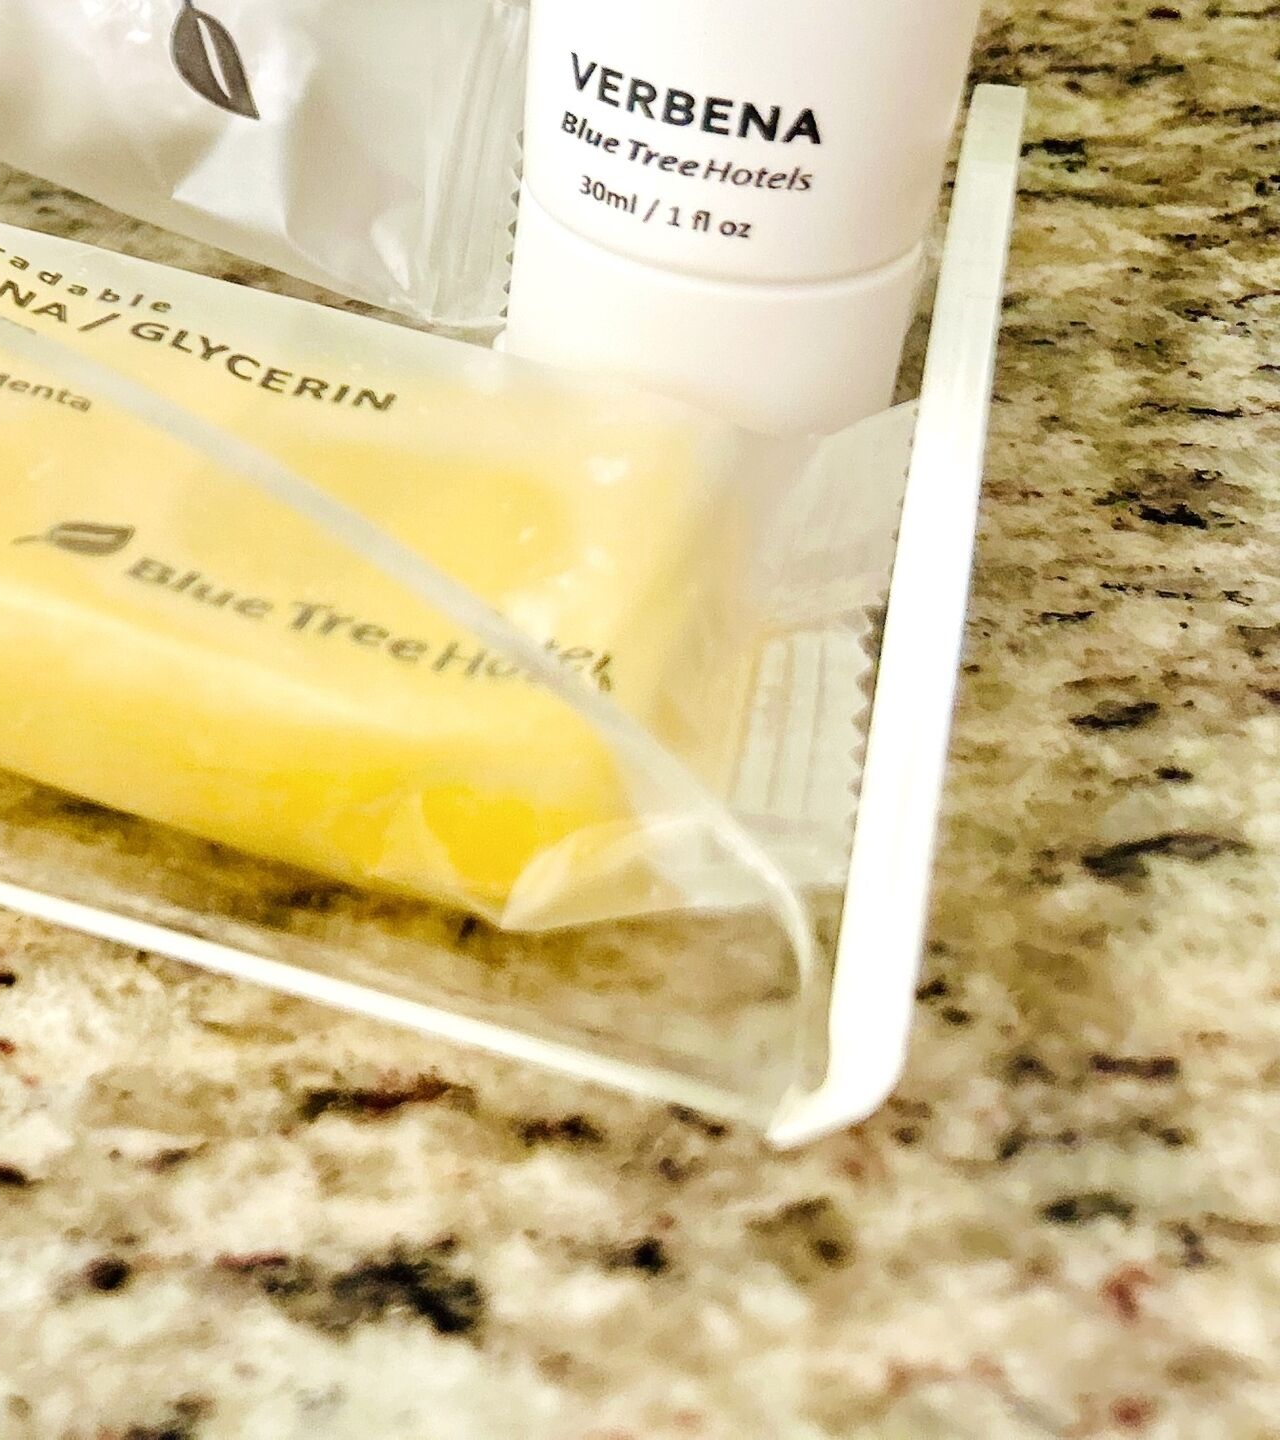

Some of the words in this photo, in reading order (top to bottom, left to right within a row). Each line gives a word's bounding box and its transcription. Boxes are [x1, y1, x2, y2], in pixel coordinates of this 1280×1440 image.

[570, 51, 822, 146] VERBENA
[560, 111, 620, 154] Blue
[627, 137, 700, 178] Tree
[702, 158, 815, 192] Hotels
[579, 174, 638, 215] 30ml
[667, 205, 681, 227] 1
[690, 209, 712, 233] fl
[719, 219, 753, 239] oz
[130, 321, 398, 412] GLYCERIN
[123, 554, 274, 620] Blue
[288, 599, 429, 665] Tree
